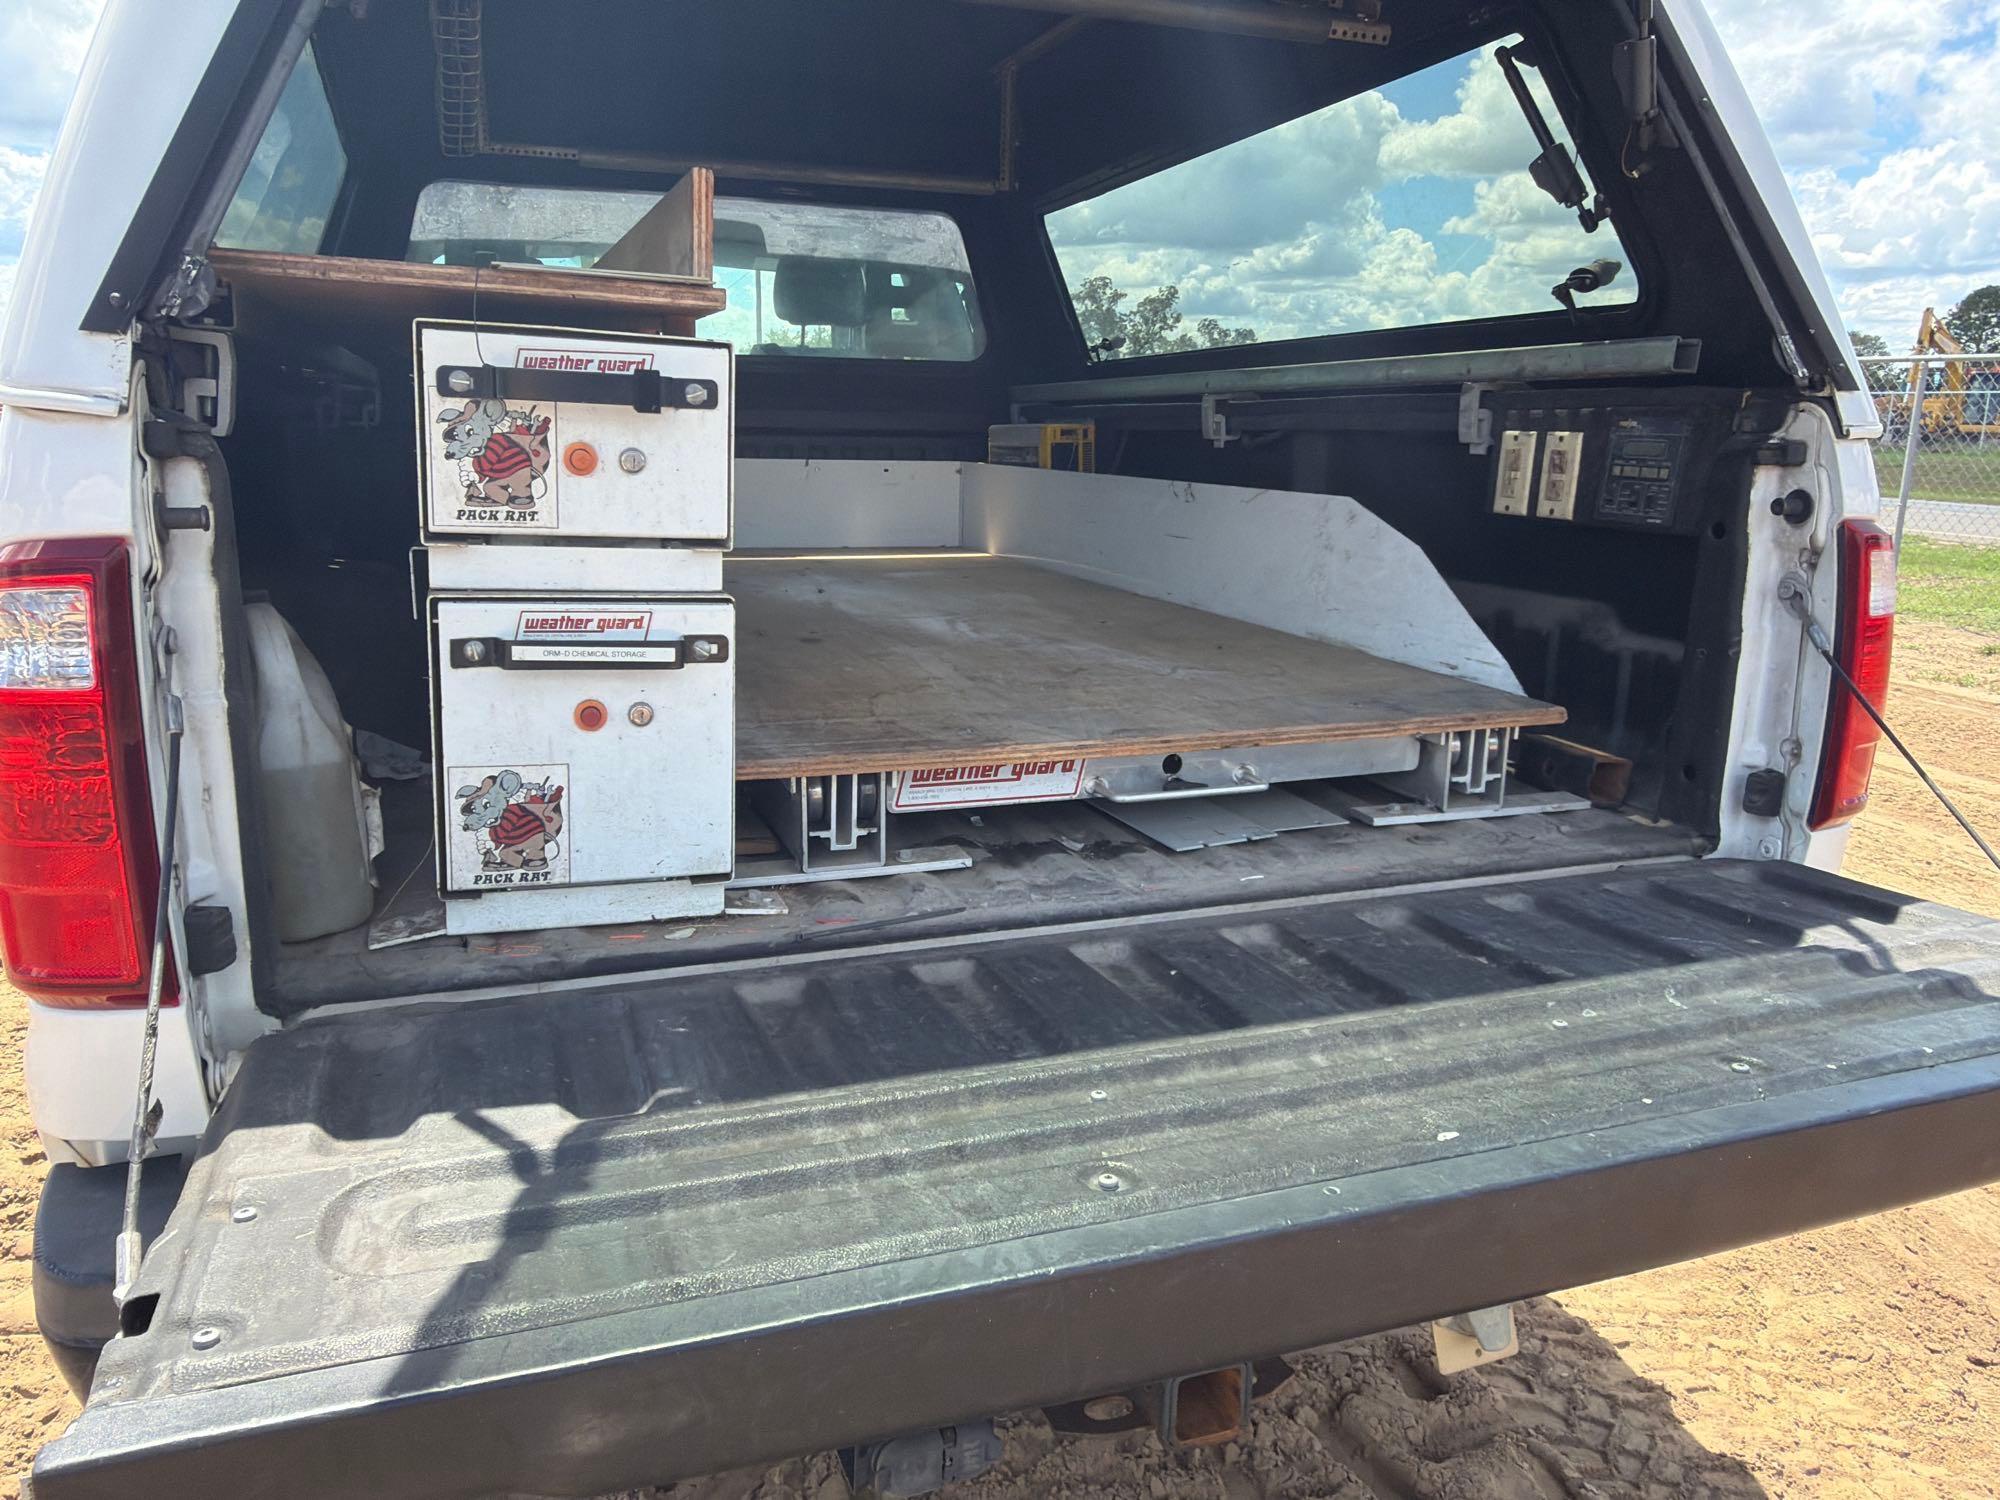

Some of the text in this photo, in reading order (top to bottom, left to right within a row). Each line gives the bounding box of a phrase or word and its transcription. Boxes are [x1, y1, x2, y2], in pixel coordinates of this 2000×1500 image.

[523, 355, 646, 373] weather guard
[456, 509, 538, 522] PACK RAT
[525, 616, 645, 632] weather guard
[543, 649, 647, 658] ORM-D CHEMICAL STORAGE
[473, 871, 551, 885] PACK RAT
